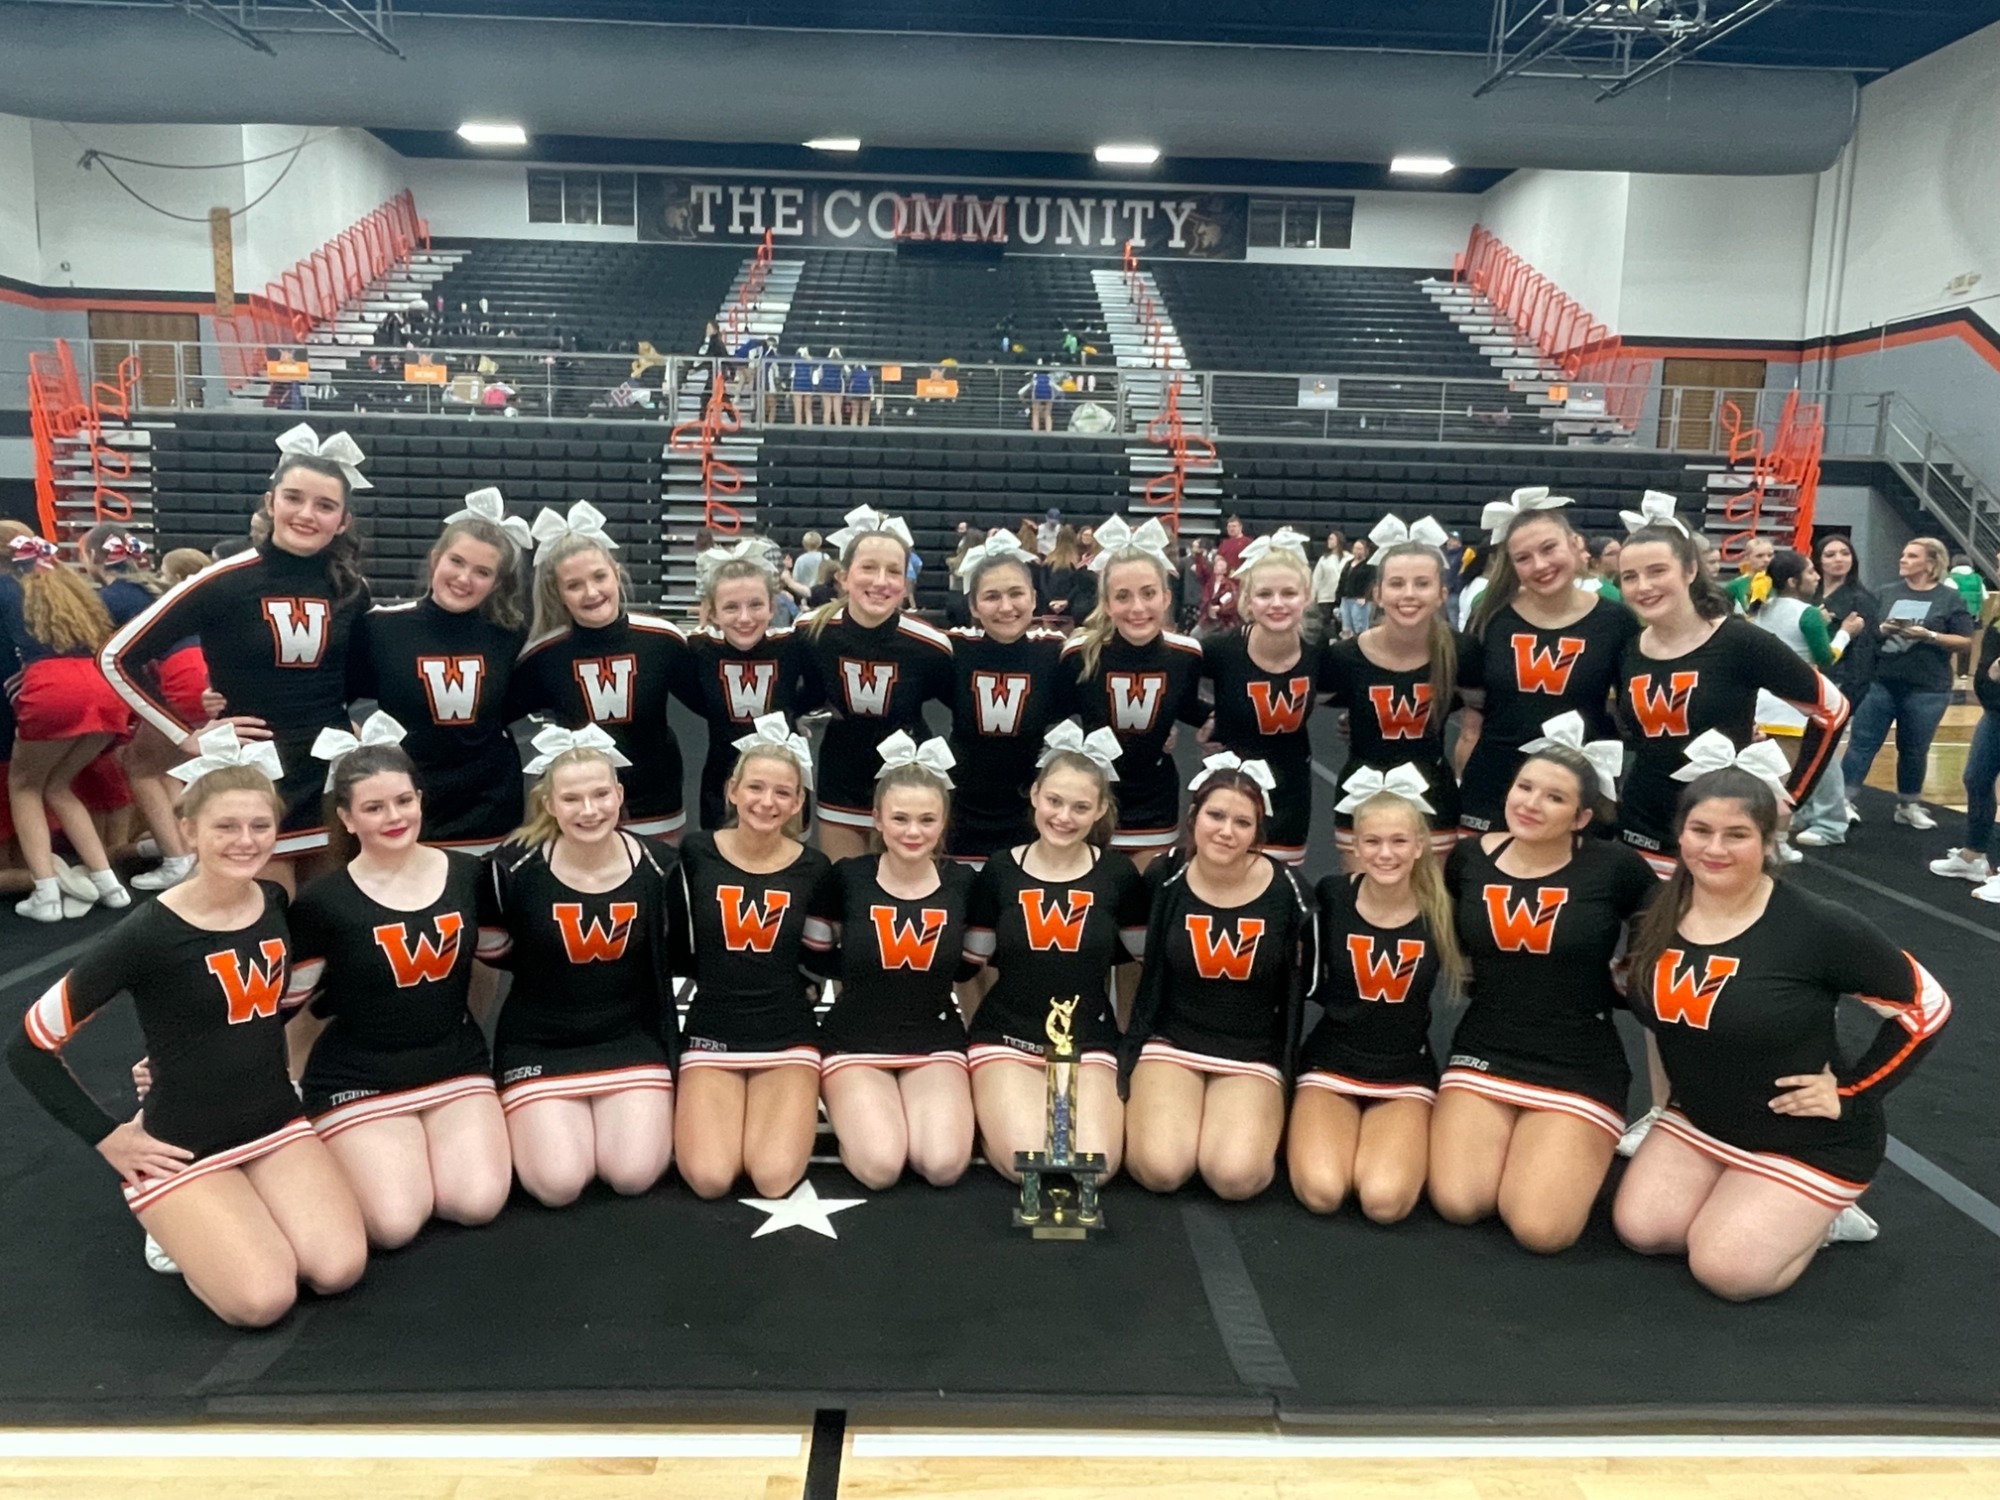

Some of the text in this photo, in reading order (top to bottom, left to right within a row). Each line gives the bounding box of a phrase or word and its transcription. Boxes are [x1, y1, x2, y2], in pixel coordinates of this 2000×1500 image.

[690, 185, 1196, 248] THE COMMUNITY
[261, 598, 331, 668] W
[1511, 634, 1585, 694] W
[417, 655, 485, 725] W
[573, 654, 637, 724] W
[719, 659, 778, 722] W
[839, 657, 898, 717] W
[971, 671, 1030, 735] W
[1106, 672, 1167, 734] W
[1247, 677, 1310, 735] W
[1369, 684, 1433, 739] W
[1630, 671, 1699, 737] W
[374, 912, 463, 987] W
[553, 902, 638, 963] W
[717, 885, 790, 953] W
[870, 905, 947, 970] W
[1019, 890, 1093, 951] W
[1185, 915, 1264, 980] W
[1482, 885, 1568, 953] W
[205, 938, 287, 1025] W
[1347, 935, 1424, 1002] W
[1653, 950, 1739, 1029] W
[1002, 1034, 1044, 1053] TIGERS
